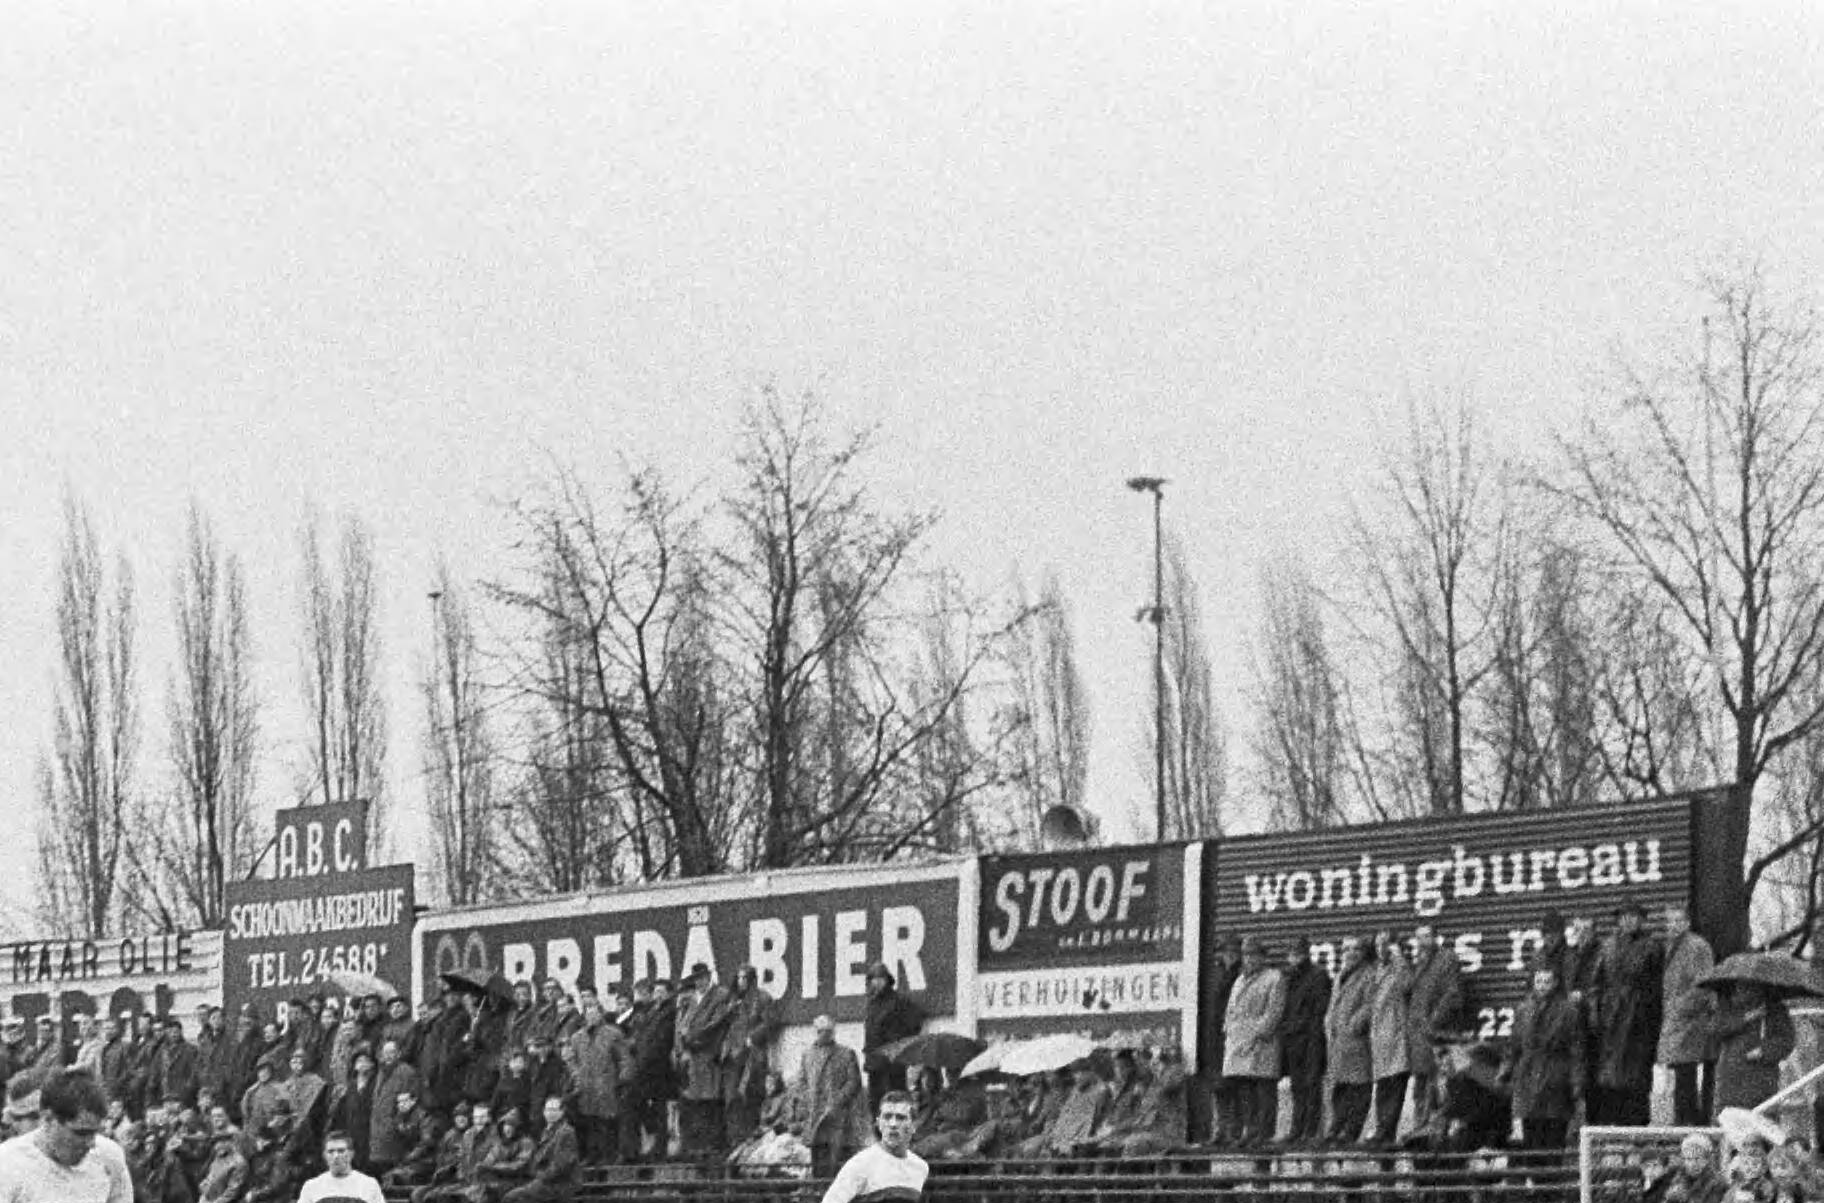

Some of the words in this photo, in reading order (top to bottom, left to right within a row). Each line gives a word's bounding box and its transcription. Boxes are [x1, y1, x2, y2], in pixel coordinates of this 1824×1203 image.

[279, 818, 359, 878] A.B.C.
[1245, 839, 1663, 916] woningbureau
[988, 860, 1151, 952] STOOF
[12, 941, 99, 986] MAAR
[119, 932, 192, 975] OLIE
[748, 904, 928, 1000] BIER
